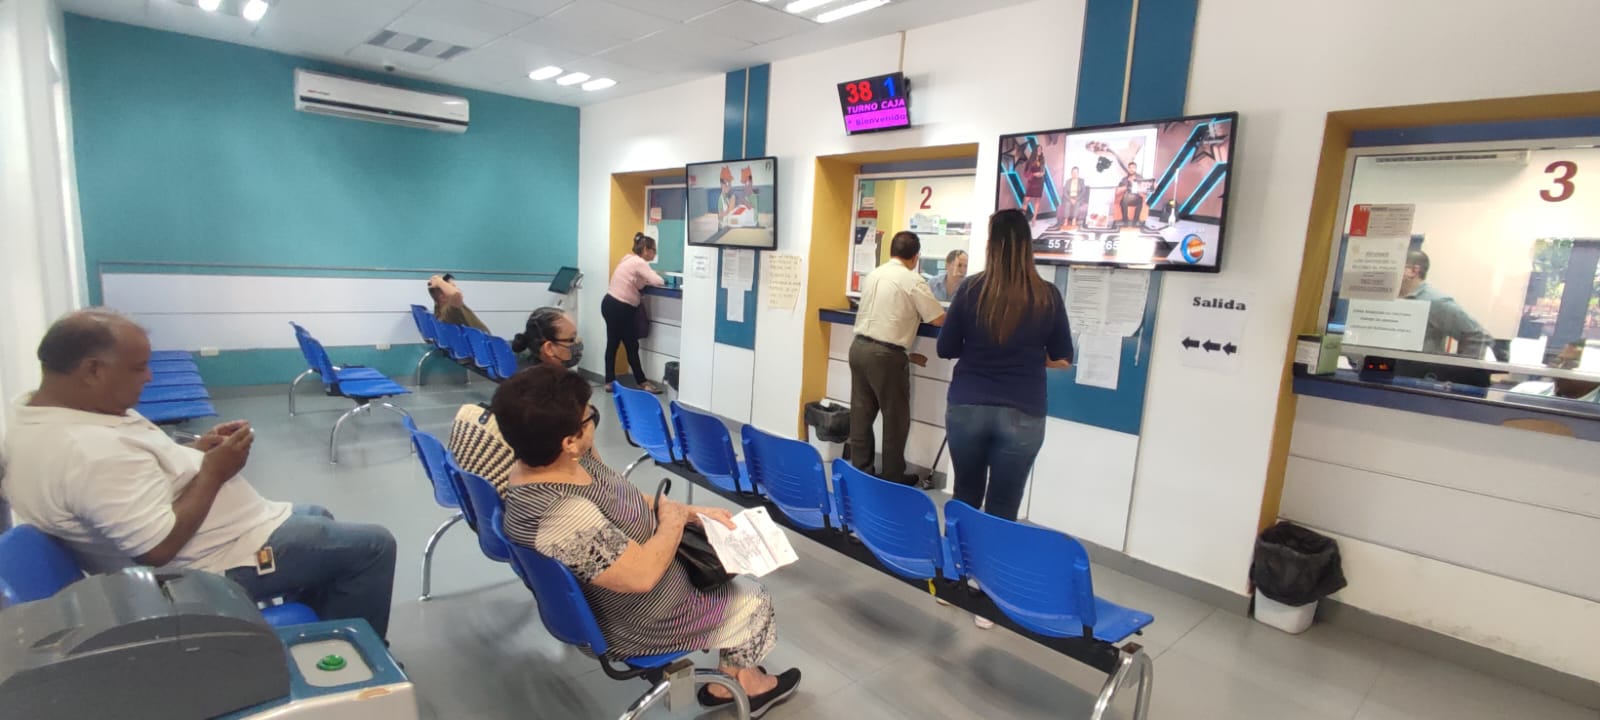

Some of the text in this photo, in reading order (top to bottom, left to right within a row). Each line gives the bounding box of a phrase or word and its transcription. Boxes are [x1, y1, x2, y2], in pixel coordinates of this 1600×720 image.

[846, 77, 895, 104] 38 1
[847, 98, 905, 114] TURNO CAJA
[1539, 160, 1578, 203] 3
[920, 185, 933, 210] 2
[1048, 239, 1061, 249] 55
[1192, 296, 1246, 311] Salida
